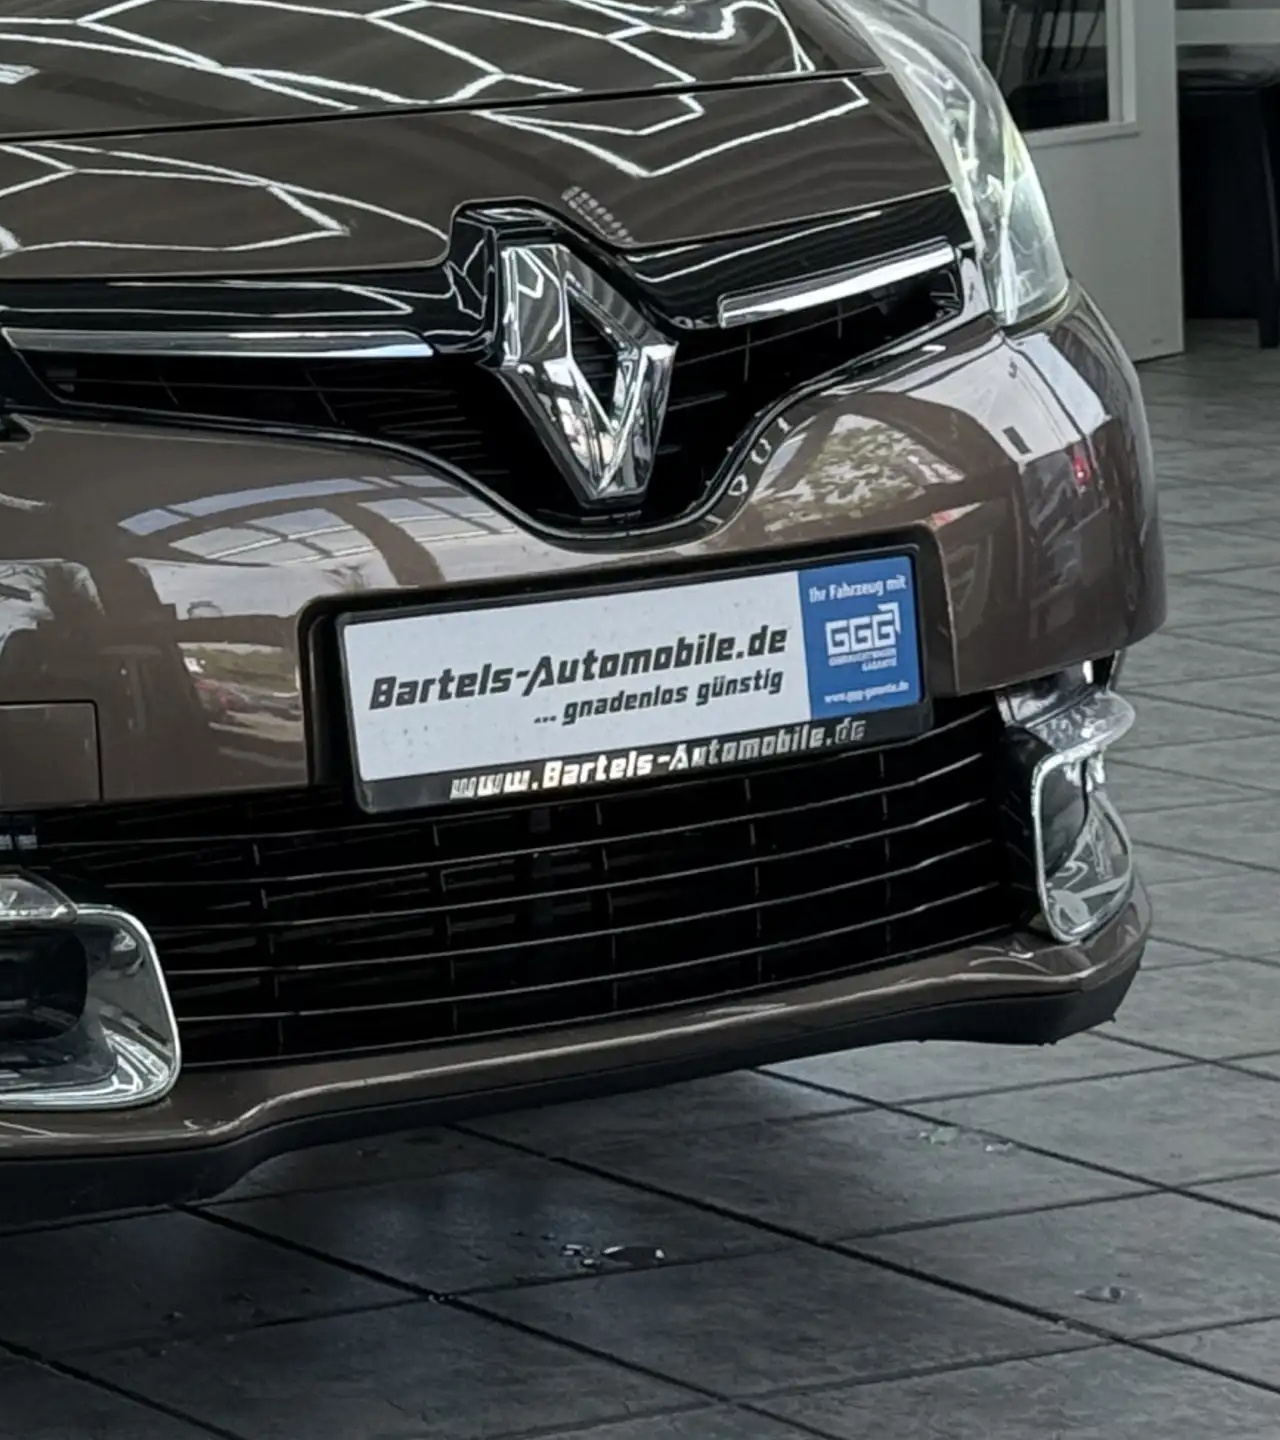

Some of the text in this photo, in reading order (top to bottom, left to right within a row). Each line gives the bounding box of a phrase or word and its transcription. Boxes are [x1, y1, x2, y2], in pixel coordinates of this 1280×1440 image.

[369, 624, 788, 710] Bartels-Automobile.de
[562, 685, 689, 726] gnadenlos
[695, 668, 784, 707] günstig
[449, 717, 866, 800] www.Bartels-Automobile.de
